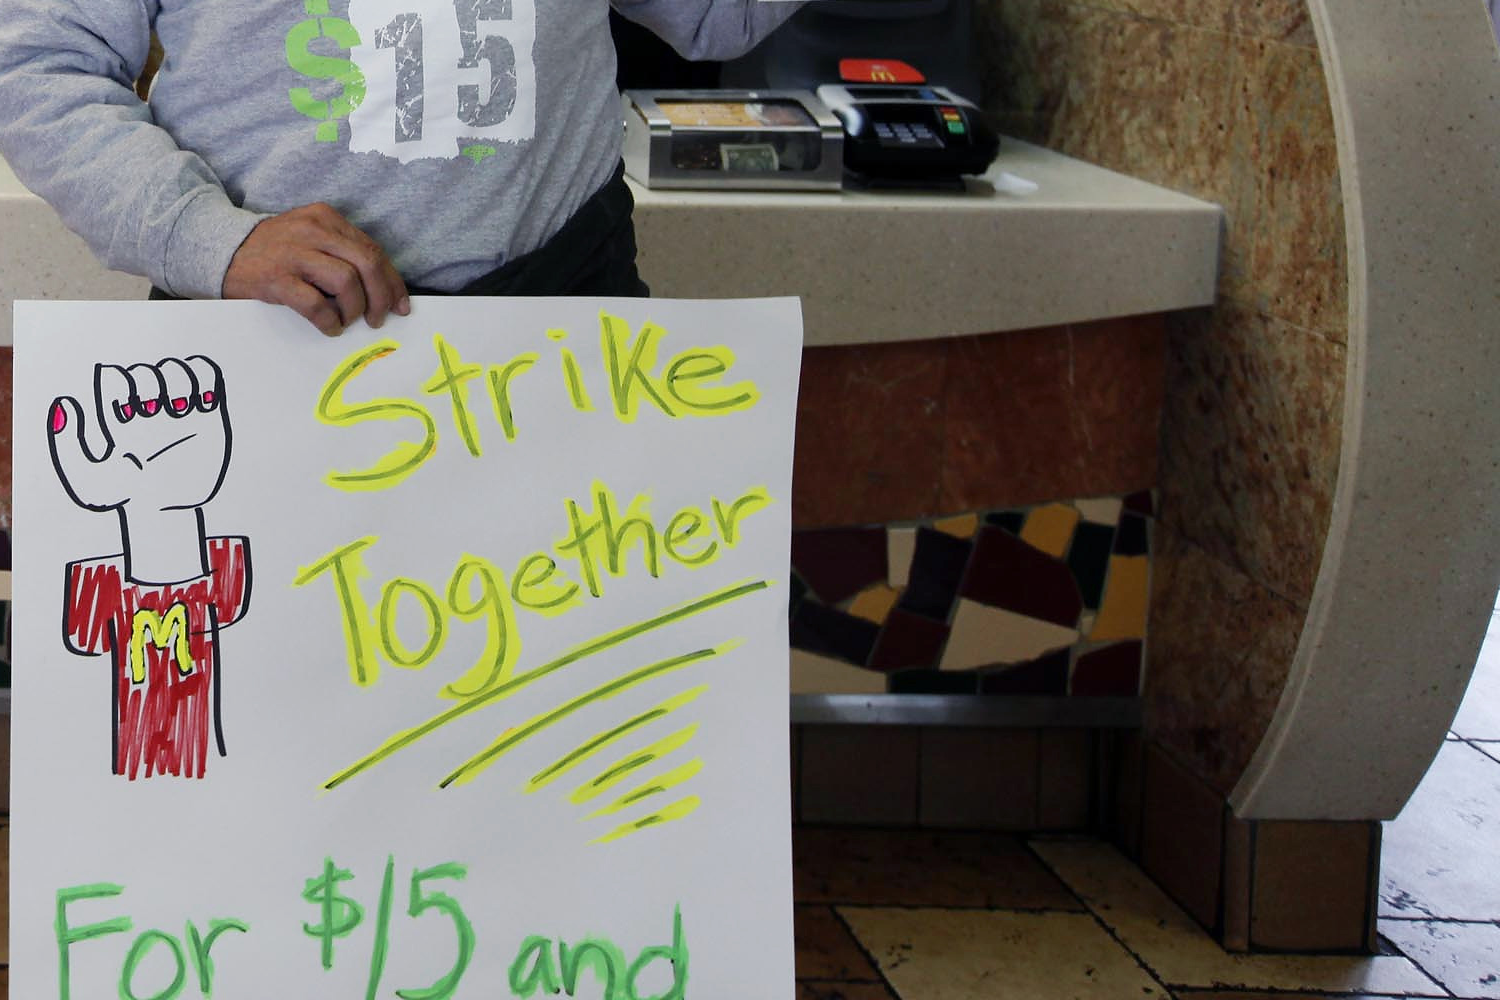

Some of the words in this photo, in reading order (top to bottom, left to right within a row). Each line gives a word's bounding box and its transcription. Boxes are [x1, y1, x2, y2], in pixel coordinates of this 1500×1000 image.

[317, 309, 760, 491] Strike
[129, 607, 193, 684] M
[293, 480, 776, 702] Together
[56, 882, 247, 1000] For
[301, 855, 477, 1000] $15
[509, 902, 689, 1000] and
